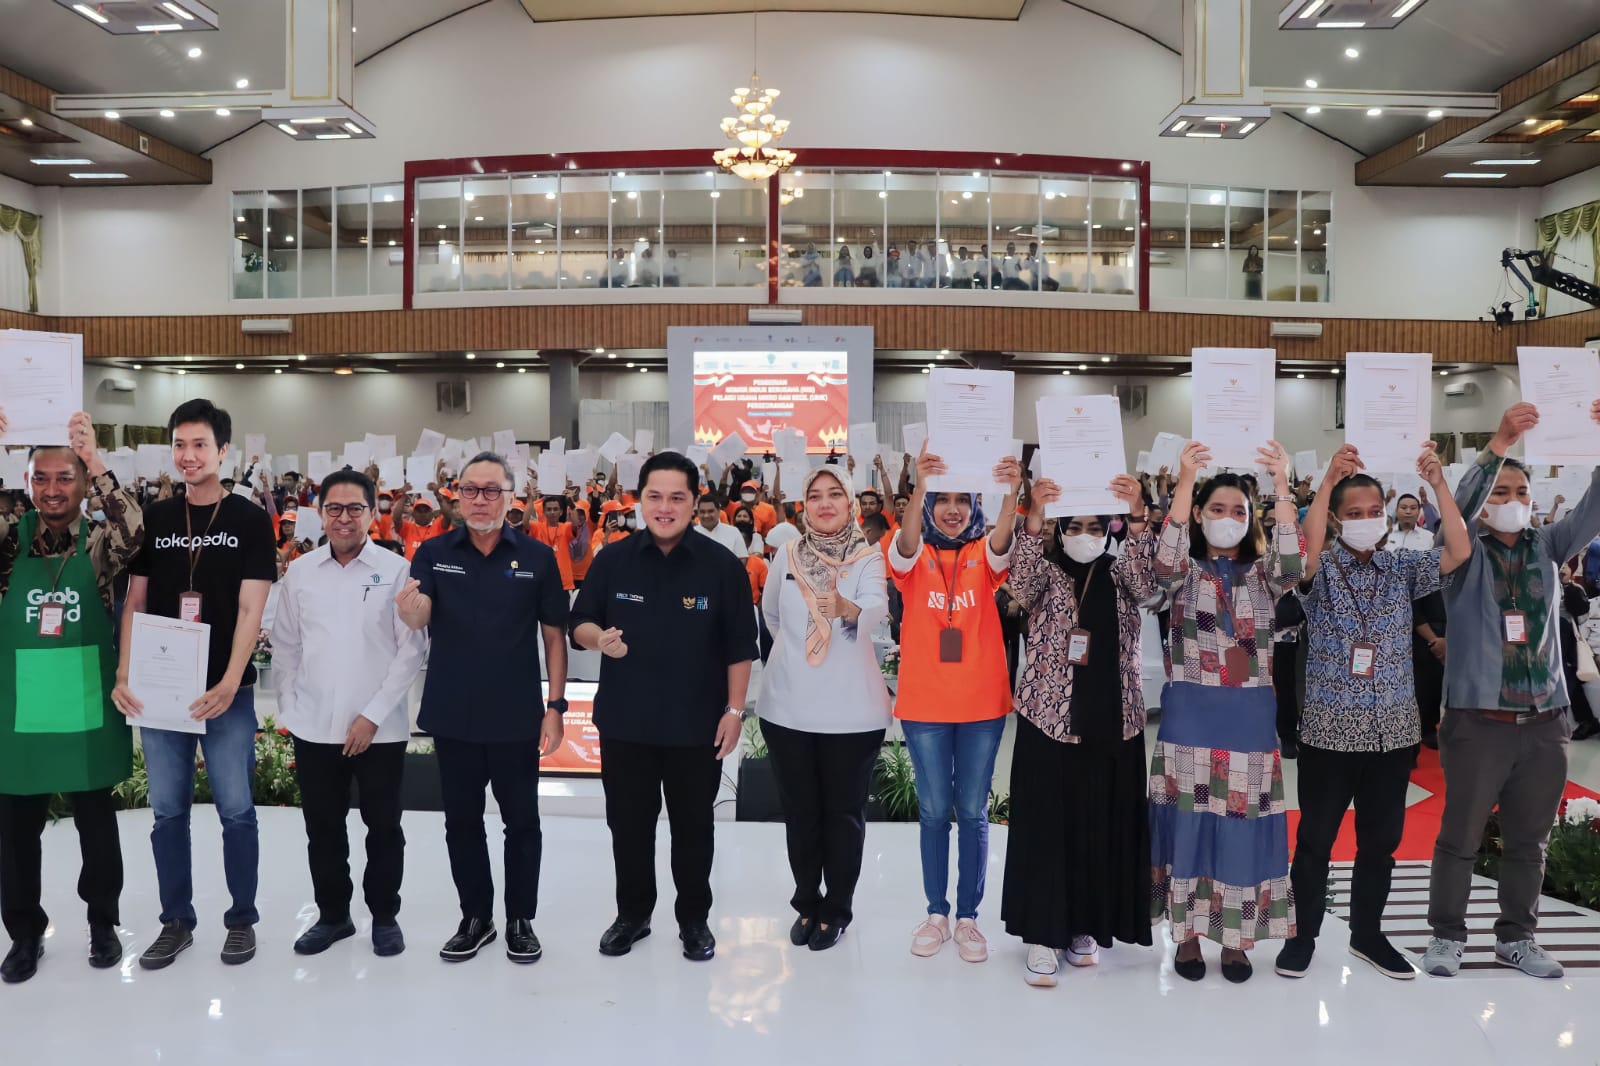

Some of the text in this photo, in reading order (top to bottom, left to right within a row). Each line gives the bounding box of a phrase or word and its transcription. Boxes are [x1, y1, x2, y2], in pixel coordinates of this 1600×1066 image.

[155, 531, 239, 552] tokopedia
[27, 586, 80, 605] Grab
[26, 604, 80, 623] Fd
